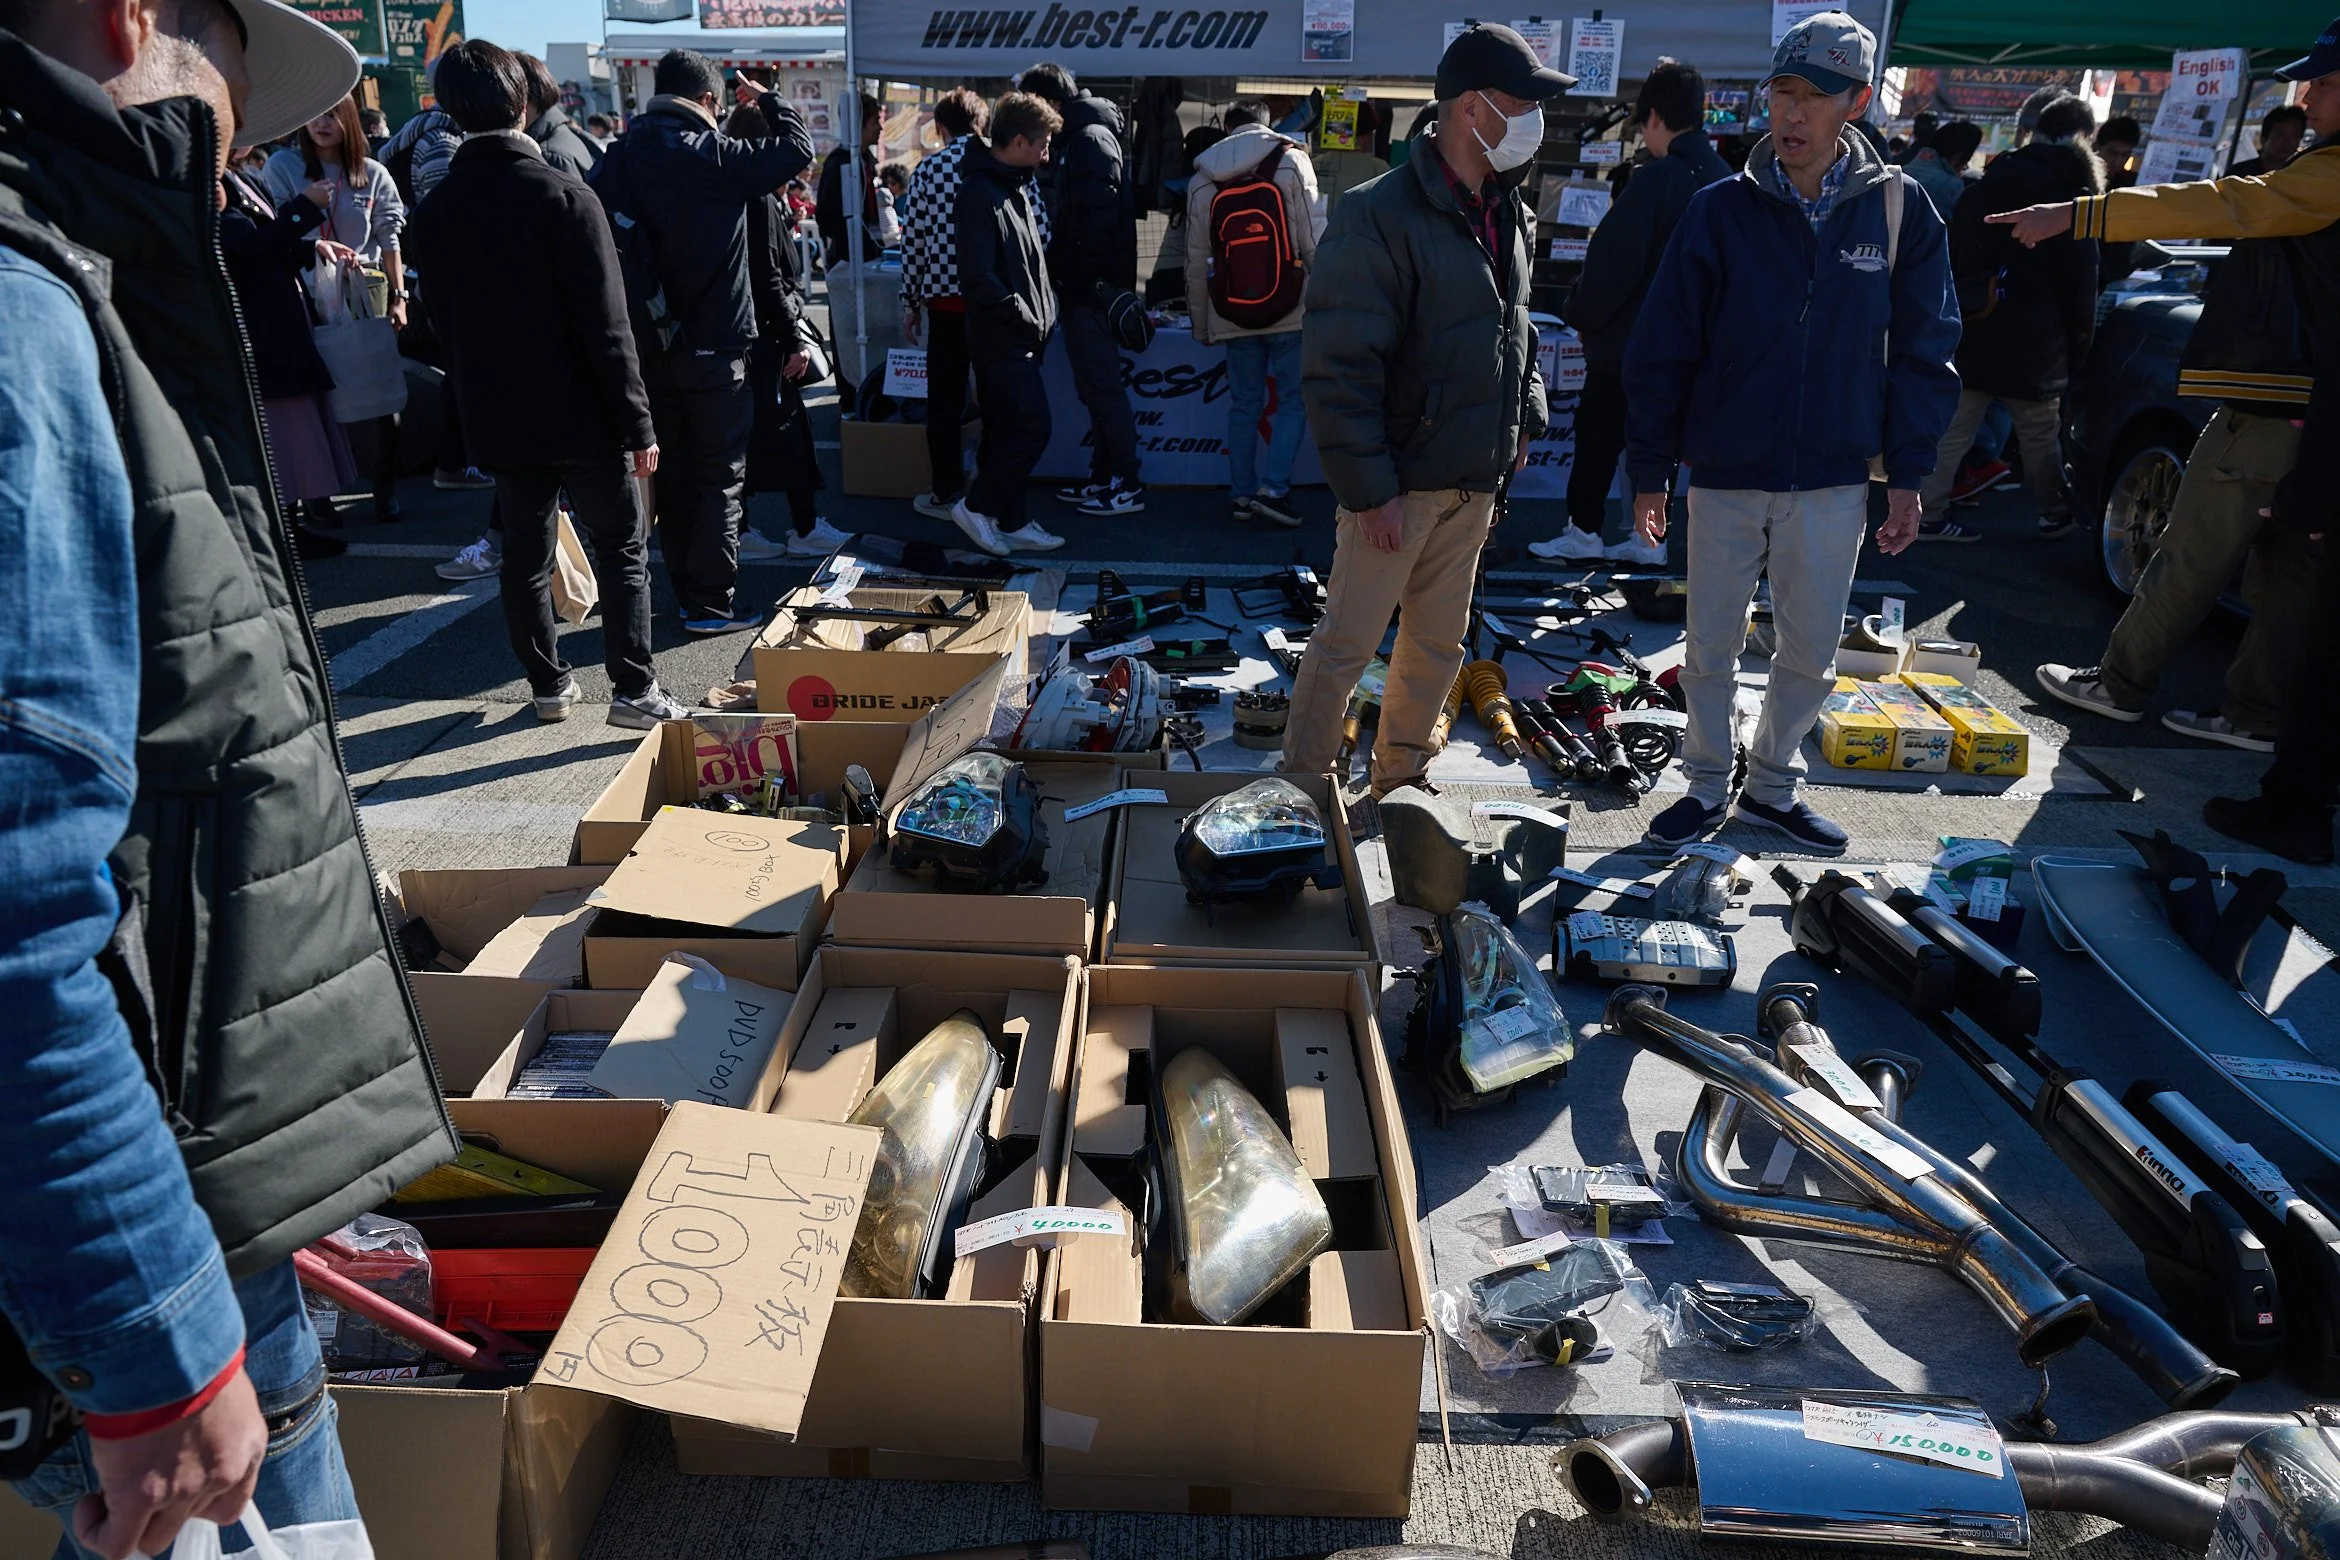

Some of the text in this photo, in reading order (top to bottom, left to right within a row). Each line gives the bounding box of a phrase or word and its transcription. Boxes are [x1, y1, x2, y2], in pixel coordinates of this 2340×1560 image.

[920, 2, 1269, 49] www.best-r.com
[2178, 56, 2236, 77] English
[2196, 79, 2221, 97] OK
[811, 693, 896, 710] BRIDE
[727, 1000, 766, 1048] DVD
[1031, 1219, 1113, 1231] 40000
[1888, 1434, 1994, 1462] 150,000
